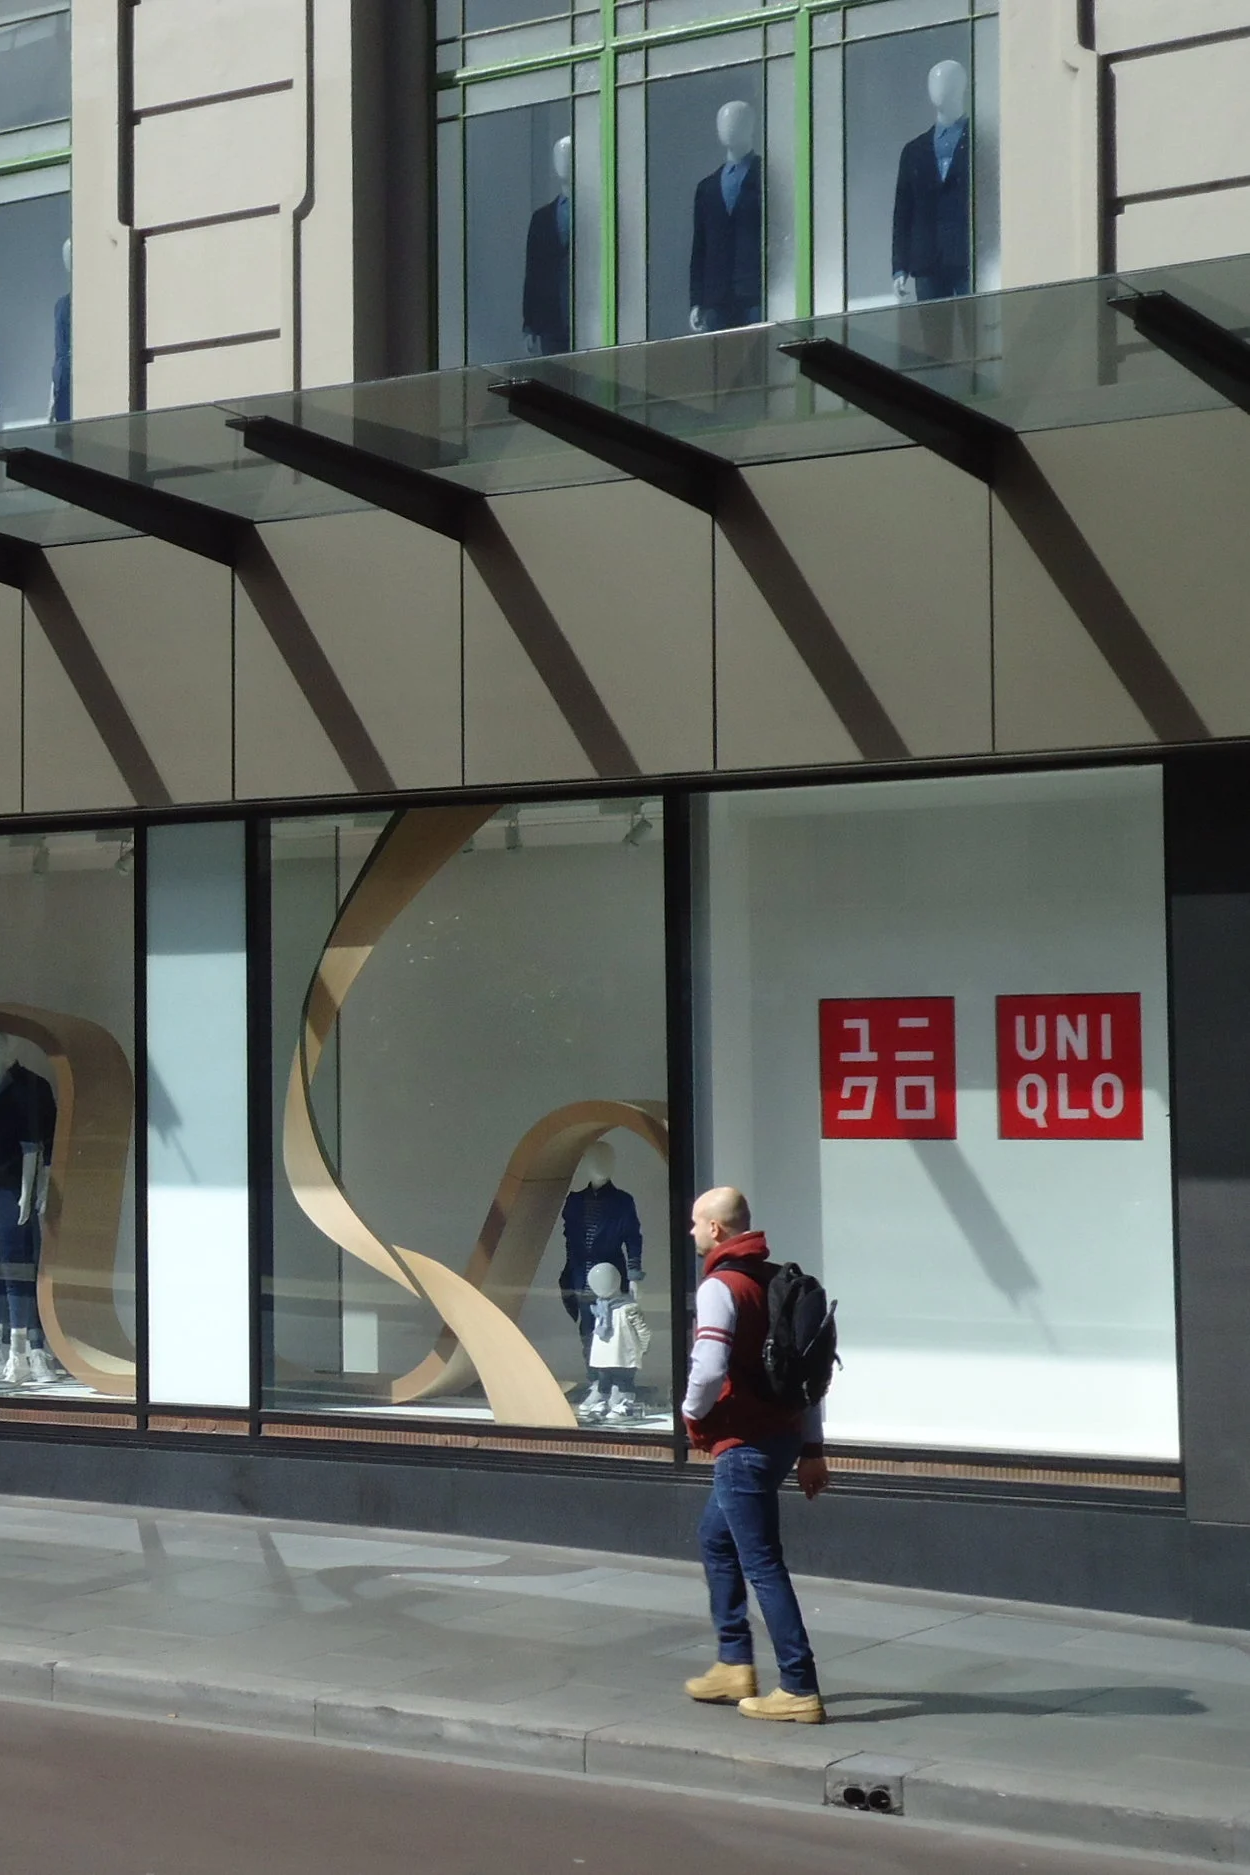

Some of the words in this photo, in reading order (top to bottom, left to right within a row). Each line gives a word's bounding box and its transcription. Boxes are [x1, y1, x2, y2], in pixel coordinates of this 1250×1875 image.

[839, 1016, 935, 1062] ユニ
[1014, 1013, 1112, 1061] UNI
[836, 1075, 936, 1121] クロ
[1015, 1072, 1124, 1128] QLO
